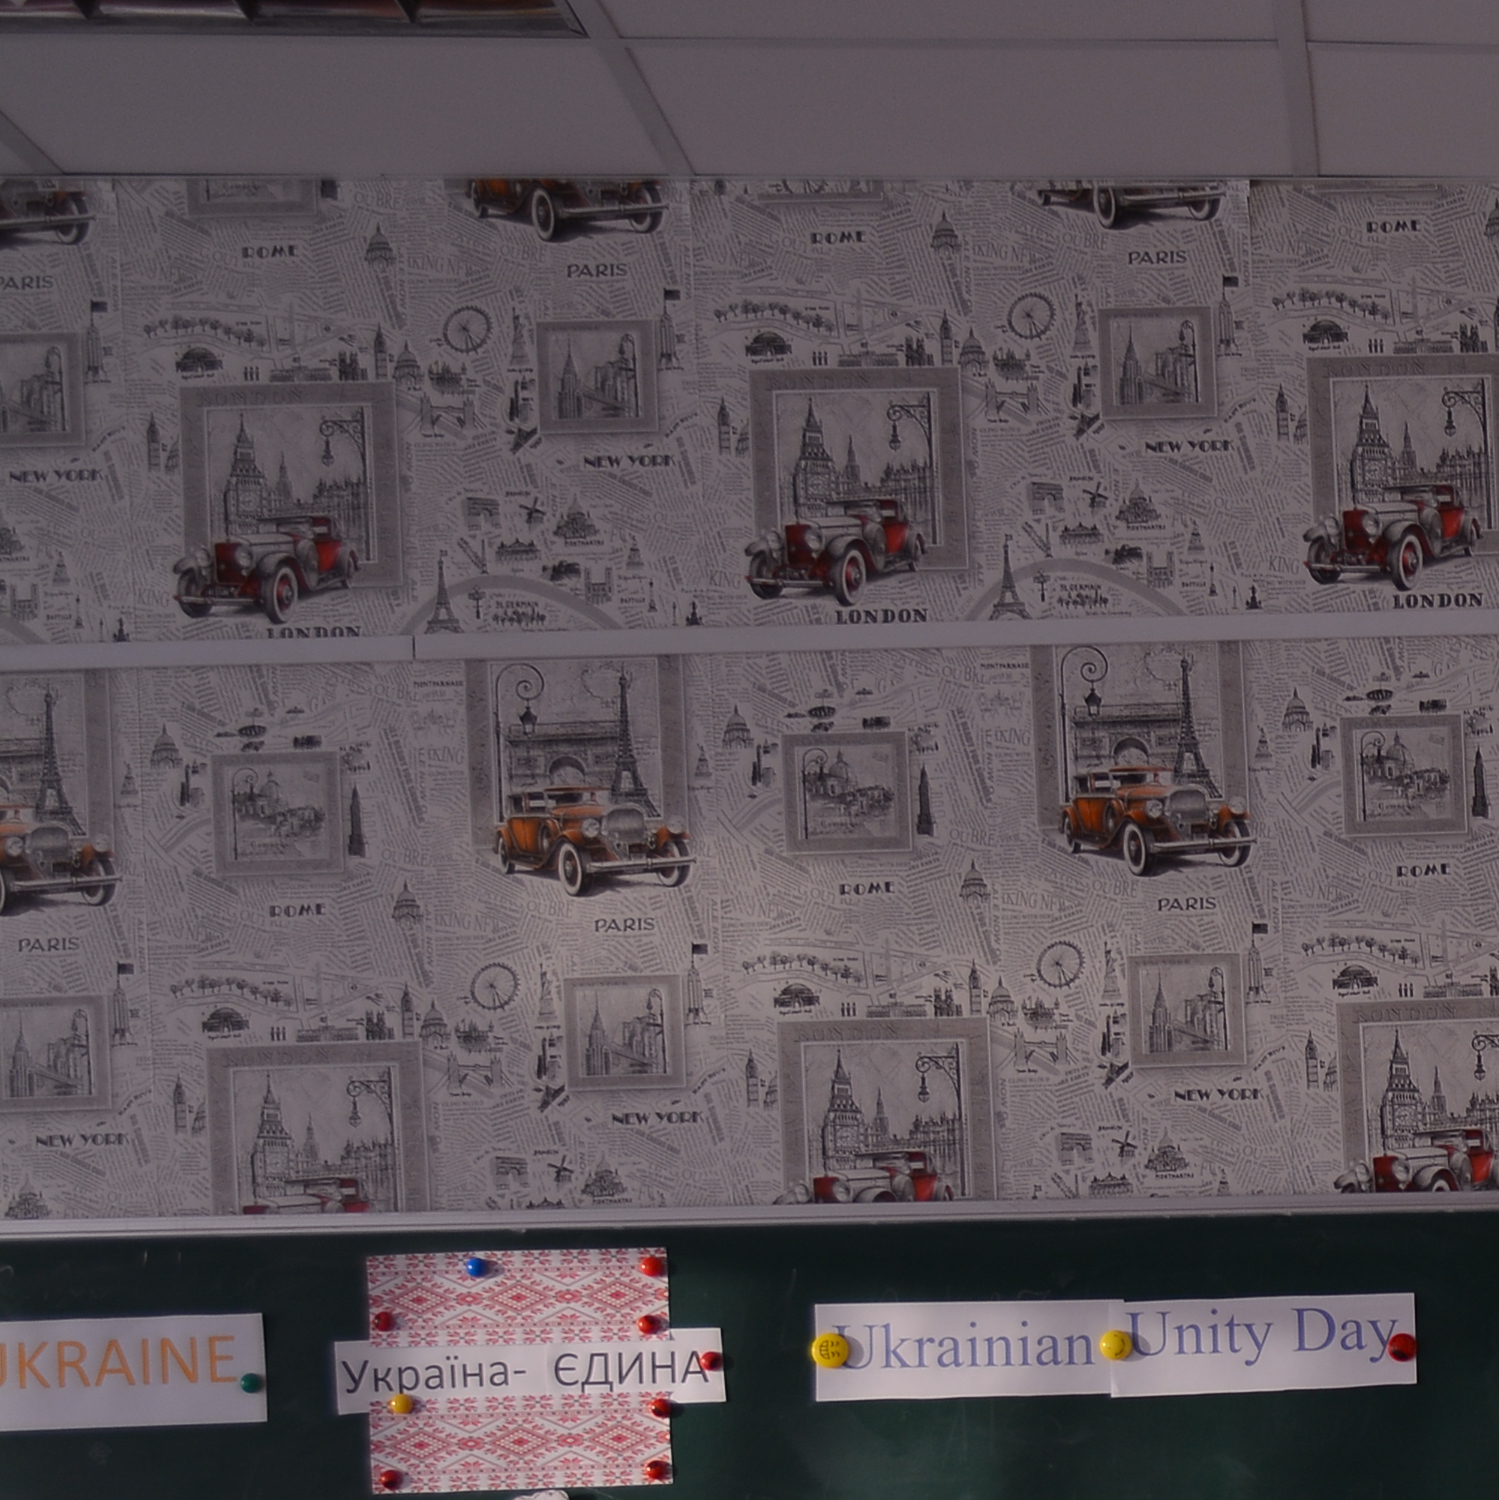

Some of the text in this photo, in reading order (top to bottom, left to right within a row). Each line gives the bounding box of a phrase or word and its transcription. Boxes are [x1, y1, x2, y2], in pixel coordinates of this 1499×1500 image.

[1366, 219, 1422, 234] ROME
[811, 230, 867, 245] ROME
[242, 243, 298, 259] ROME
[1128, 249, 1188, 265] PARIS
[567, 262, 628, 278] PARIS
[1145, 439, 1235, 454] NEW YORK
[583, 453, 677, 469] NEW YORK
[9, 467, 103, 484] NEW YORK
[1393, 592, 1484, 611] LONDON
[836, 607, 928, 626] LONDON
[266, 625, 362, 639] LONDON
[1397, 862, 1452, 878] ROME
[839, 881, 895, 896] ROME
[269, 903, 326, 919] ROME
[1157, 897, 1218, 912] PARIS
[595, 917, 656, 933] PARIS
[18, 935, 80, 953] PARIS
[1174, 1088, 1264, 1103] NEW YORK
[612, 1110, 704, 1126] NEW YORK
[35, 1133, 130, 1148] NEW YORK
[832, 1306, 1399, 1371] Ukrainian Unity Day
[0, 1335, 237, 1390] KRAINE
[341, 1350, 710, 1395] Україна- ЄДИНА
